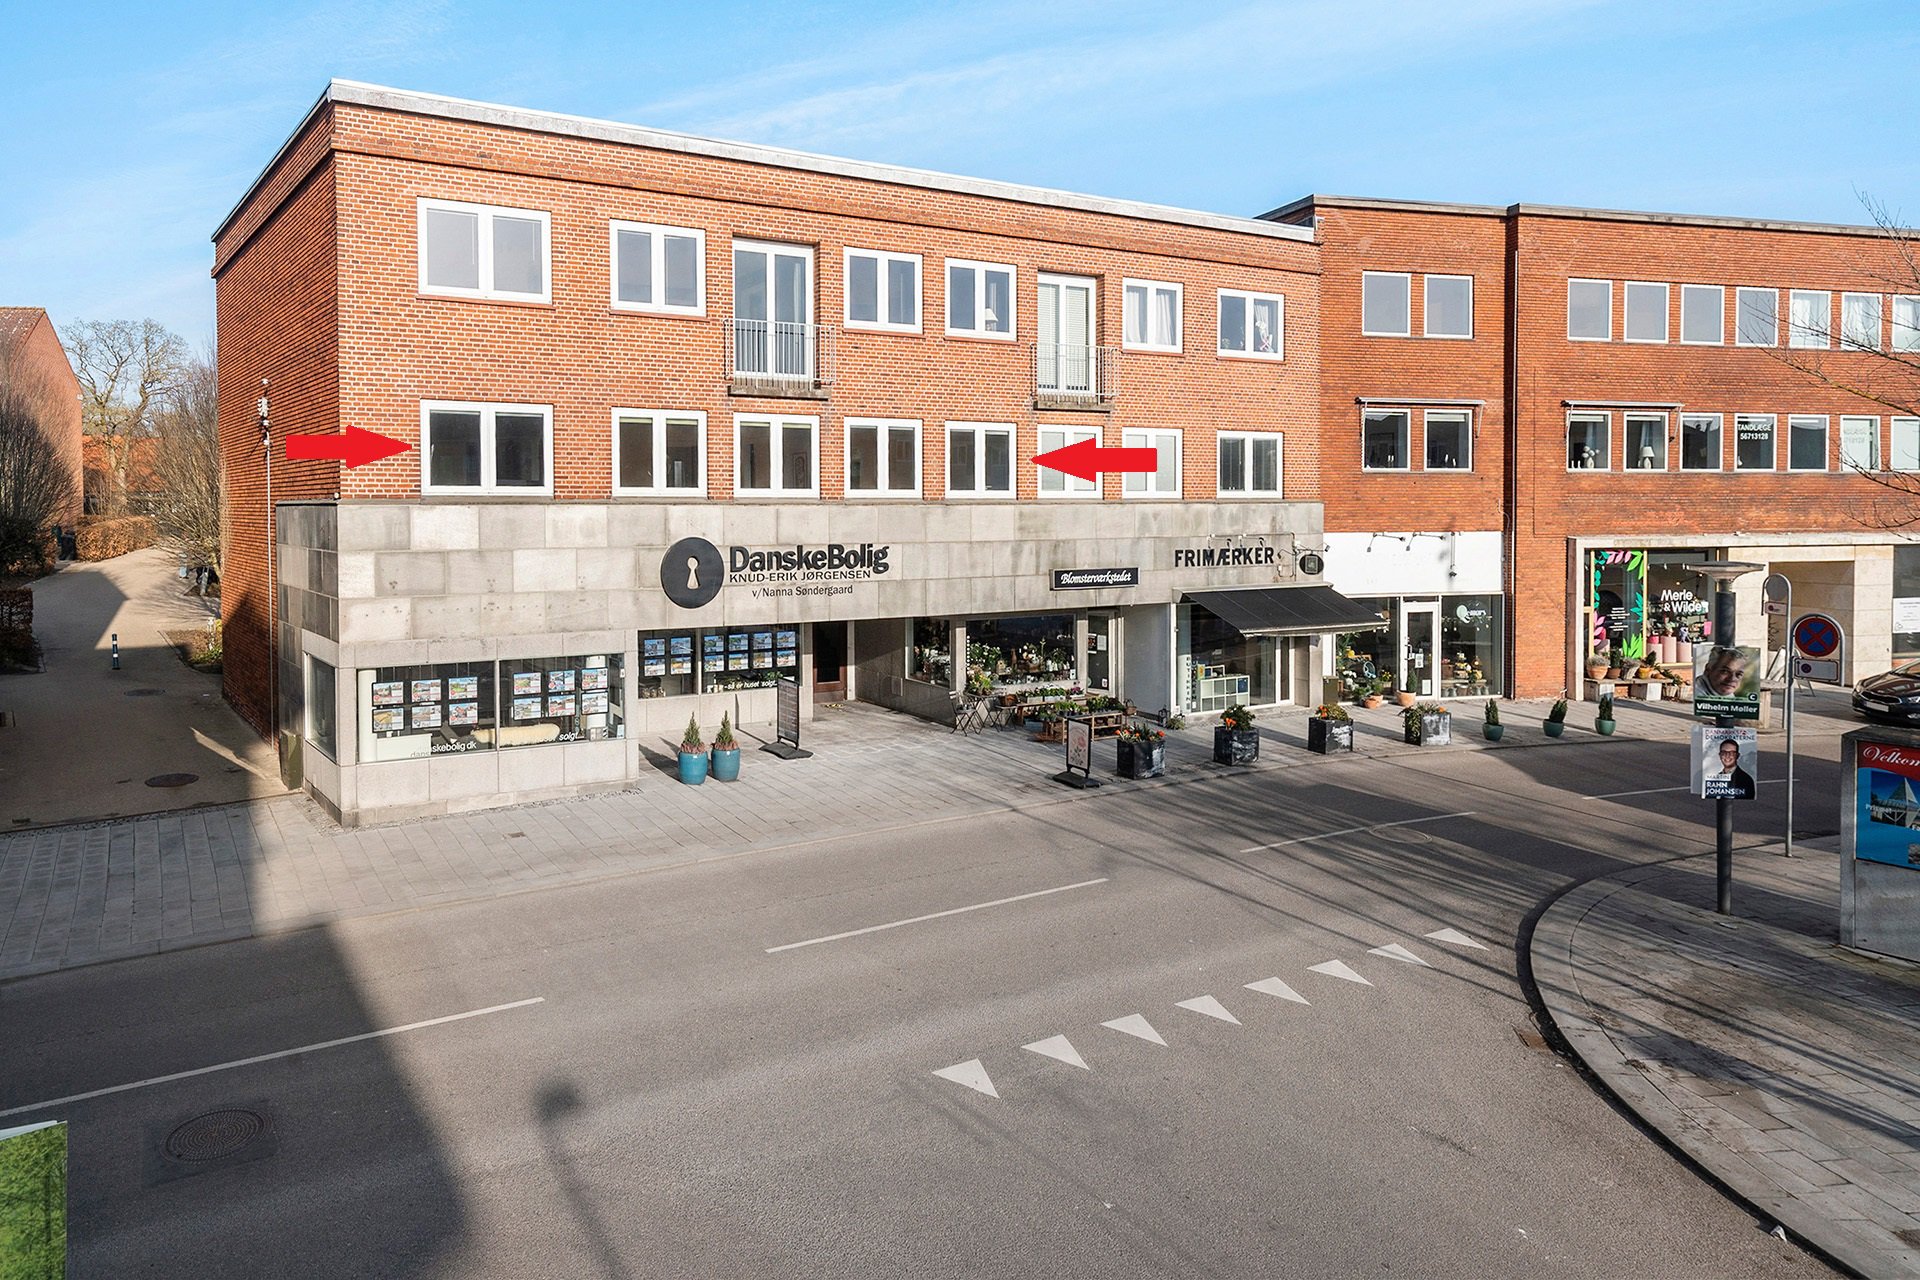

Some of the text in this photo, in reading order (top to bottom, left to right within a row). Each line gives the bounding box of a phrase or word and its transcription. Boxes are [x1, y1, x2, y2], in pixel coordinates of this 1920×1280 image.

[1737, 423, 1772, 432] TANDLÆGE
[729, 543, 890, 574] DanskeBolig
[1174, 547, 1275, 567] FRIMÆRKER
[729, 570, 871, 583] KNUD-ERIK JØRGENSEN
[1060, 569, 1132, 585] Blomsterværkstedet
[752, 585, 853, 599] v/Nanna Søndergaard
[1660, 589, 1694, 602] Merle
[1663, 601, 1702, 613] & Wilde
[1696, 702, 1729, 711] Vilhelm
[1706, 788, 1745, 796] JOHANSEN
